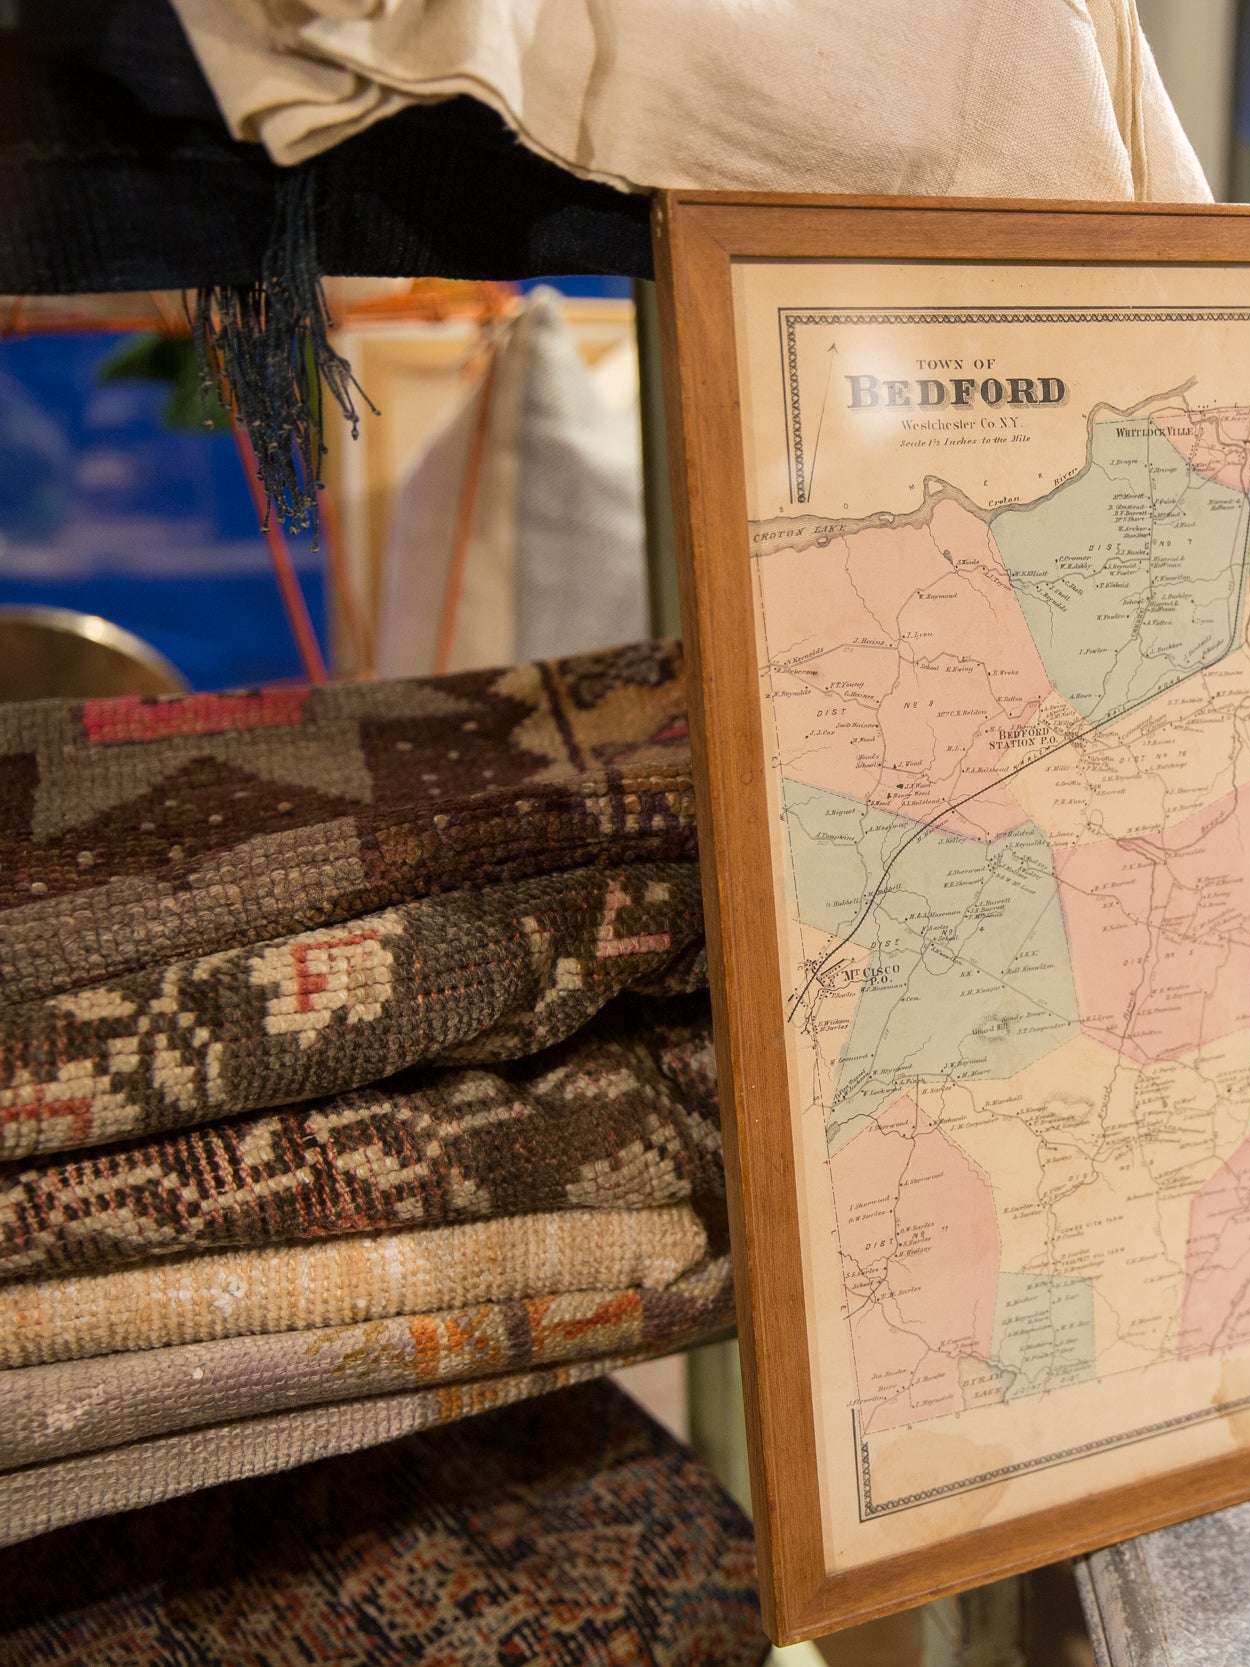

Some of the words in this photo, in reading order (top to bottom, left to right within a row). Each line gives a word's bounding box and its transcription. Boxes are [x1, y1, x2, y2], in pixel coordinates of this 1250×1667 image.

[917, 359, 964, 370] TOWN
[974, 359, 996, 369] OF
[845, 374, 1070, 413] BEDFORD
[901, 419, 976, 430] Westchester
[944, 437, 976, 446] Inches
[1011, 434, 1031, 442] Mile
[988, 496, 1020, 507] Croton
[1053, 468, 1077, 486] River
[753, 527, 804, 544] CROTON
[813, 524, 847, 534] LAKE
[999, 727, 1049, 740] BEDFORD
[989, 739, 1038, 750] STATION
[863, 964, 900, 977] CISCO
